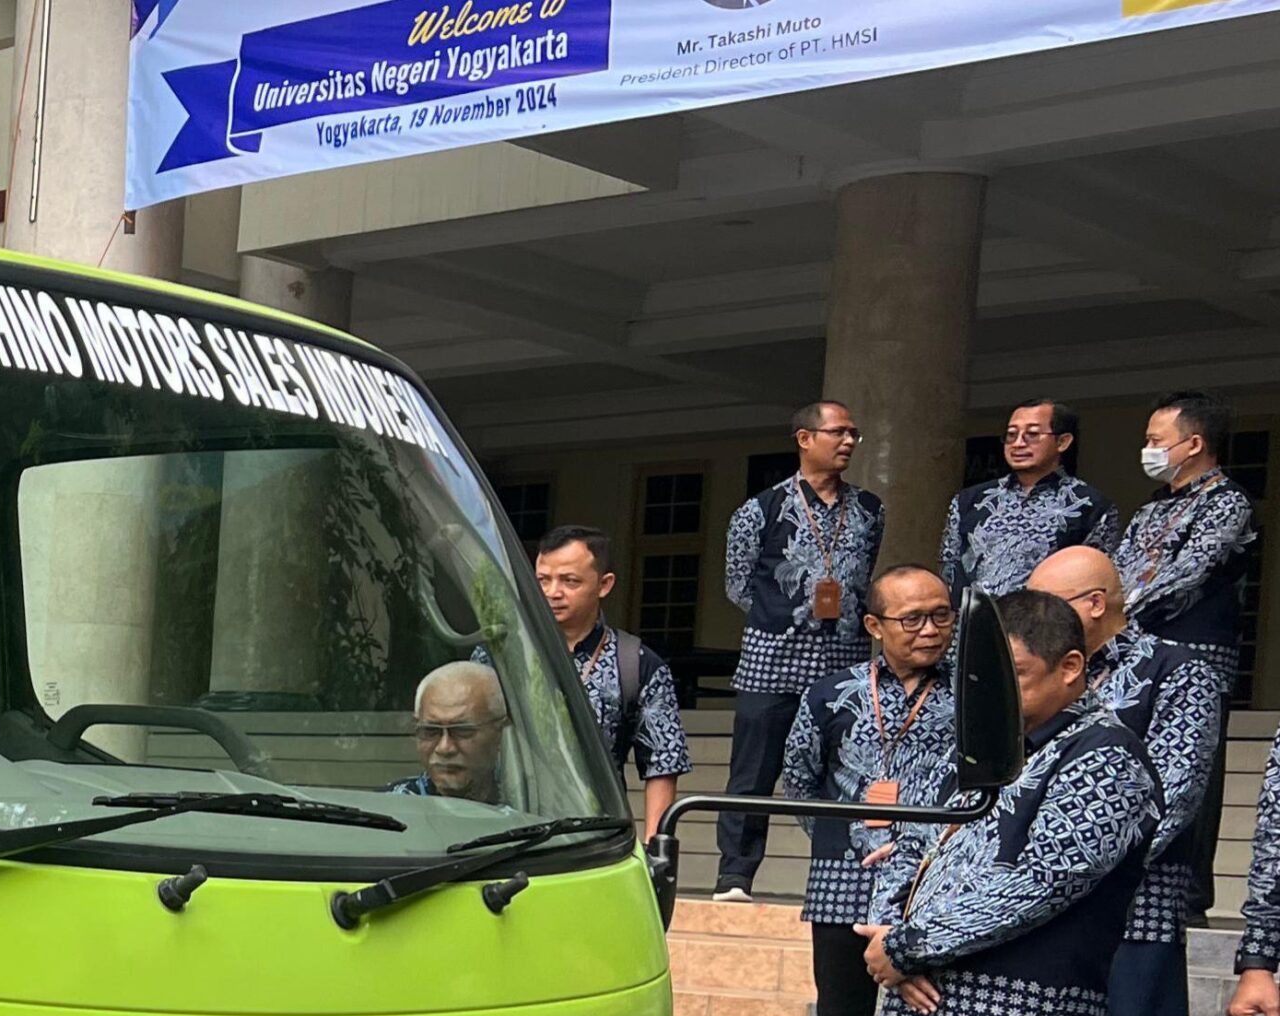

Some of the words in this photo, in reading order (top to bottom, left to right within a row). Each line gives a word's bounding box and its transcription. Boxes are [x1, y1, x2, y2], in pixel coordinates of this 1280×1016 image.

[407, 0, 533, 47] Welcome
[676, 40, 704, 56] Mr.
[708, 23, 772, 50] Takashi
[776, 16, 822, 36] Muto
[253, 70, 366, 112] Universitas
[371, 50, 441, 95] Negeri
[446, 29, 568, 82] Yogyakarta
[620, 62, 700, 87] President
[704, 49, 774, 75] Director
[778, 42, 797, 61] of
[800, 37, 827, 56] PT.
[832, 26, 879, 50] HMSI
[316, 113, 402, 148] Yogyakarta,
[409, 106, 429, 130] 19
[429, 94, 512, 127] November
[515, 82, 558, 114] 2024
[64, 296, 225, 402] MOTORS
[203, 322, 320, 420] SALES
[293, 342, 449, 459] INDONESIA
